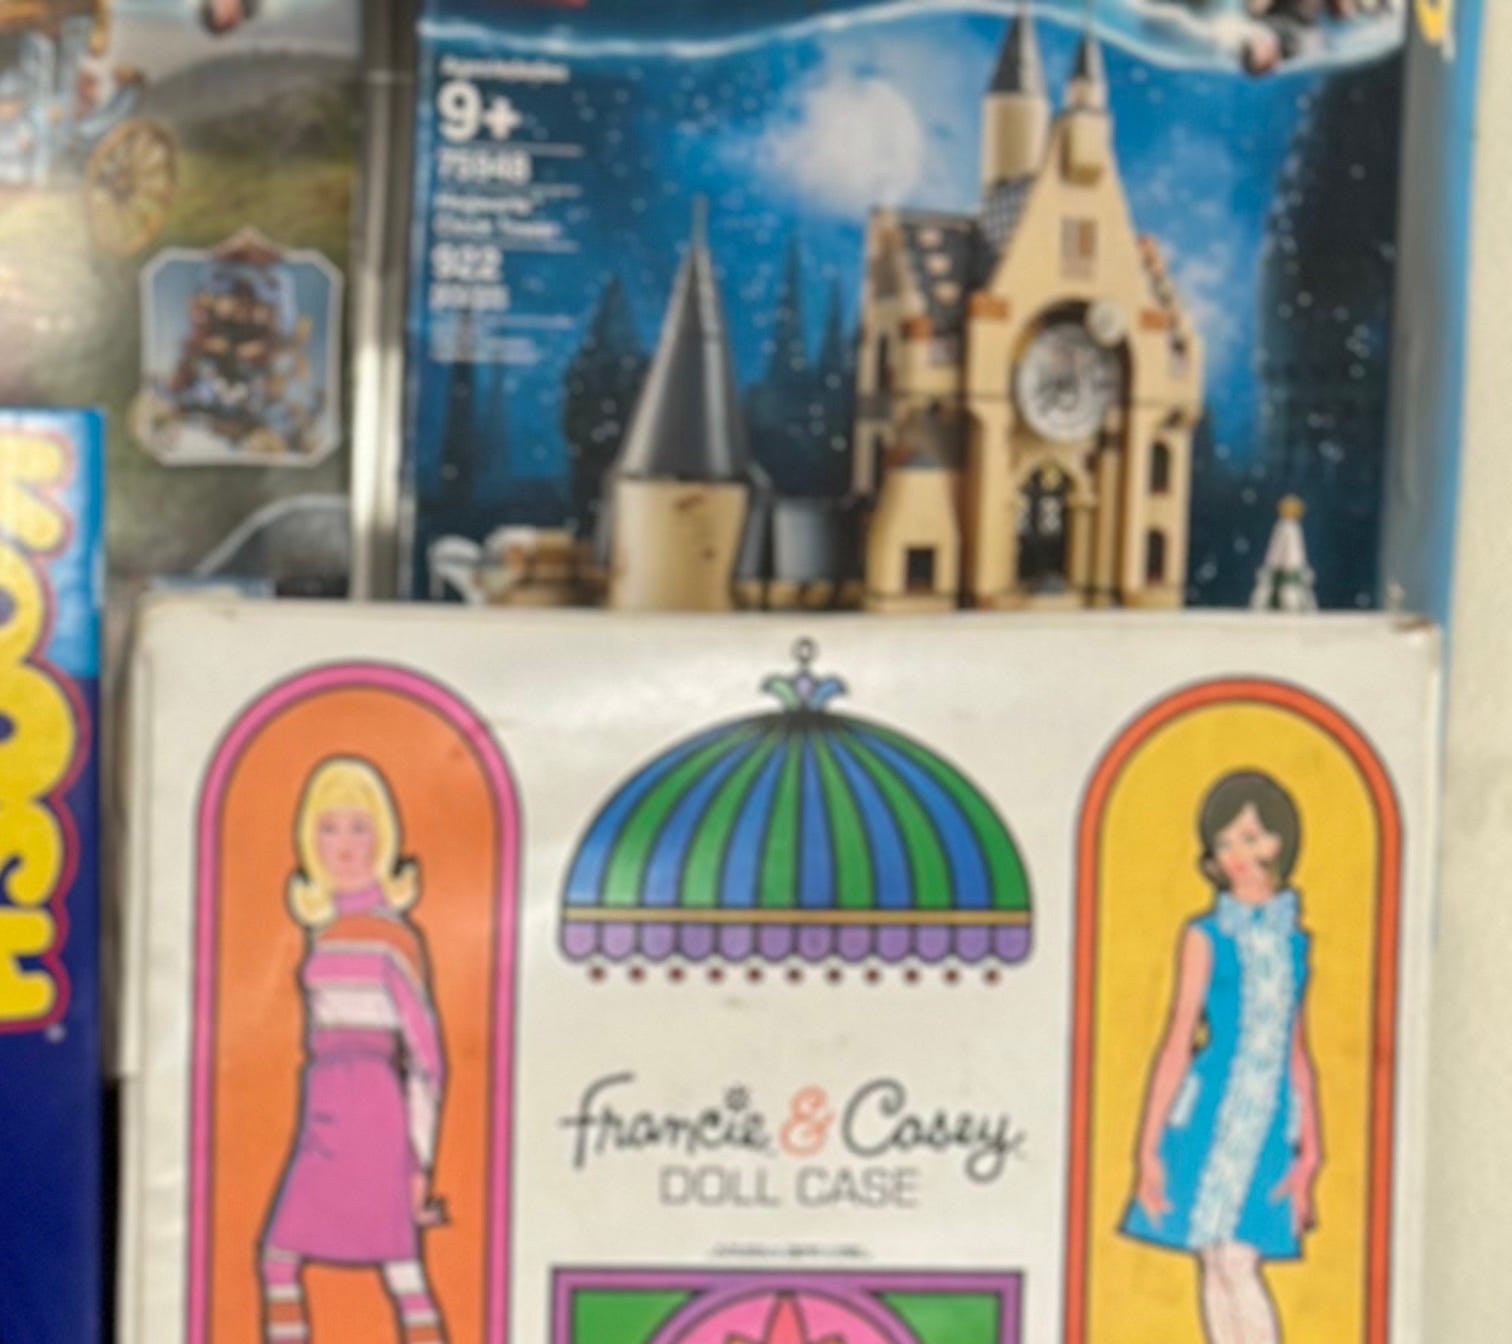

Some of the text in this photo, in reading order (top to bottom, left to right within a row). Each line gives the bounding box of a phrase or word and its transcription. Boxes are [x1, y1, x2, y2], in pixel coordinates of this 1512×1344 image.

[438, 79, 522, 142] 9+
[558, 1073, 1026, 1185] Francie & Casey
[659, 1166, 919, 1207] DOLL CASE
